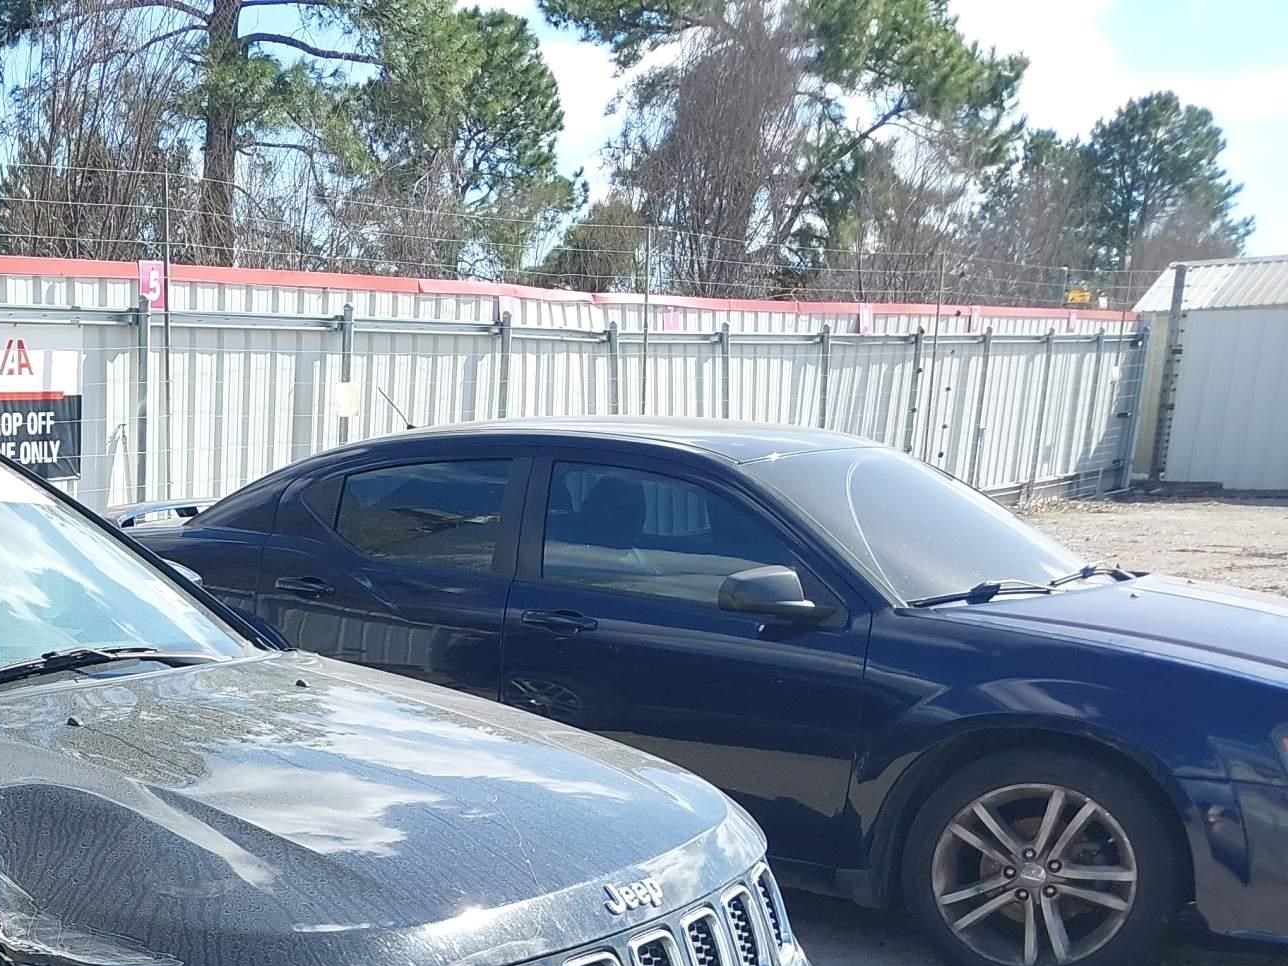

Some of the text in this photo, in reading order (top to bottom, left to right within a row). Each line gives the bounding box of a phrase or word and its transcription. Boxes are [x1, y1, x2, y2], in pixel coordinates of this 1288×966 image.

[147, 270, 161, 301] 5
[26, 411, 55, 435] OFF
[19, 440, 61, 465] ONLY
[602, 877, 664, 916] Jeep
